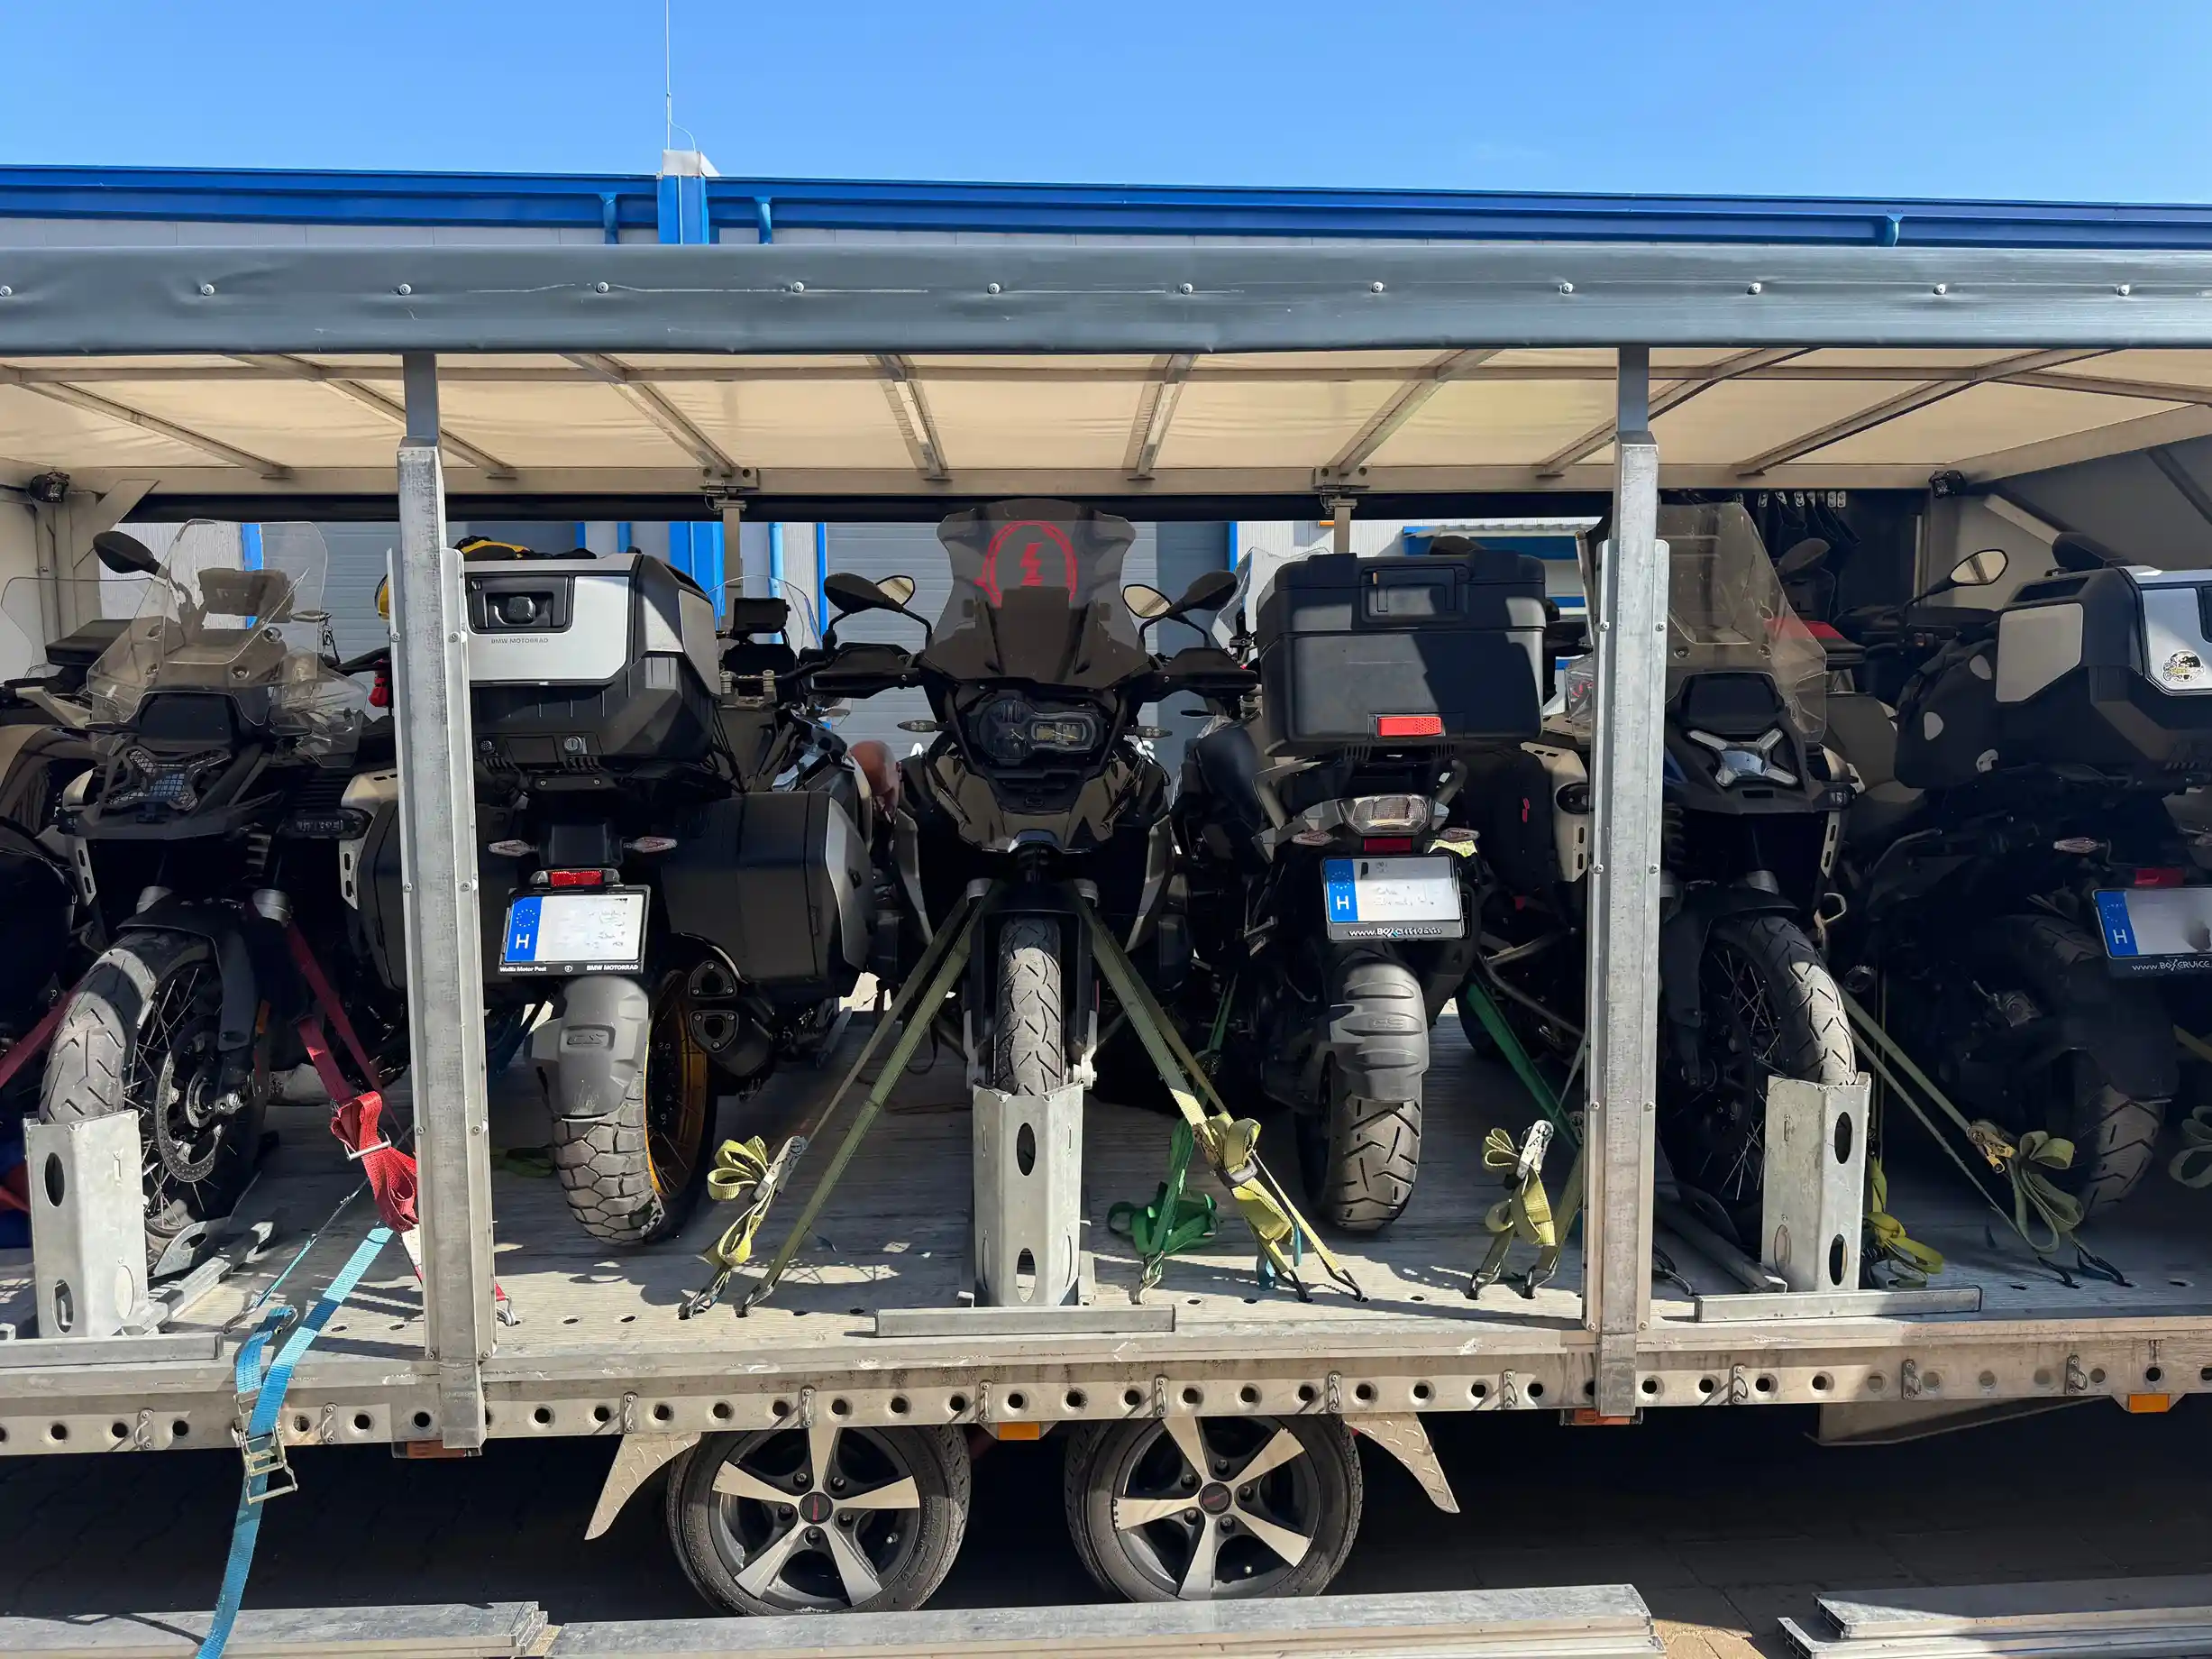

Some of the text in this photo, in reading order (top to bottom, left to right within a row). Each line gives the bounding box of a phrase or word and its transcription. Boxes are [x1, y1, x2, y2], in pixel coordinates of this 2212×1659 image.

[1336, 895, 1350, 911] H
[515, 933, 530, 949] H
[2112, 929, 2128, 945] H
[602, 963, 639, 971] MOTORRAD
